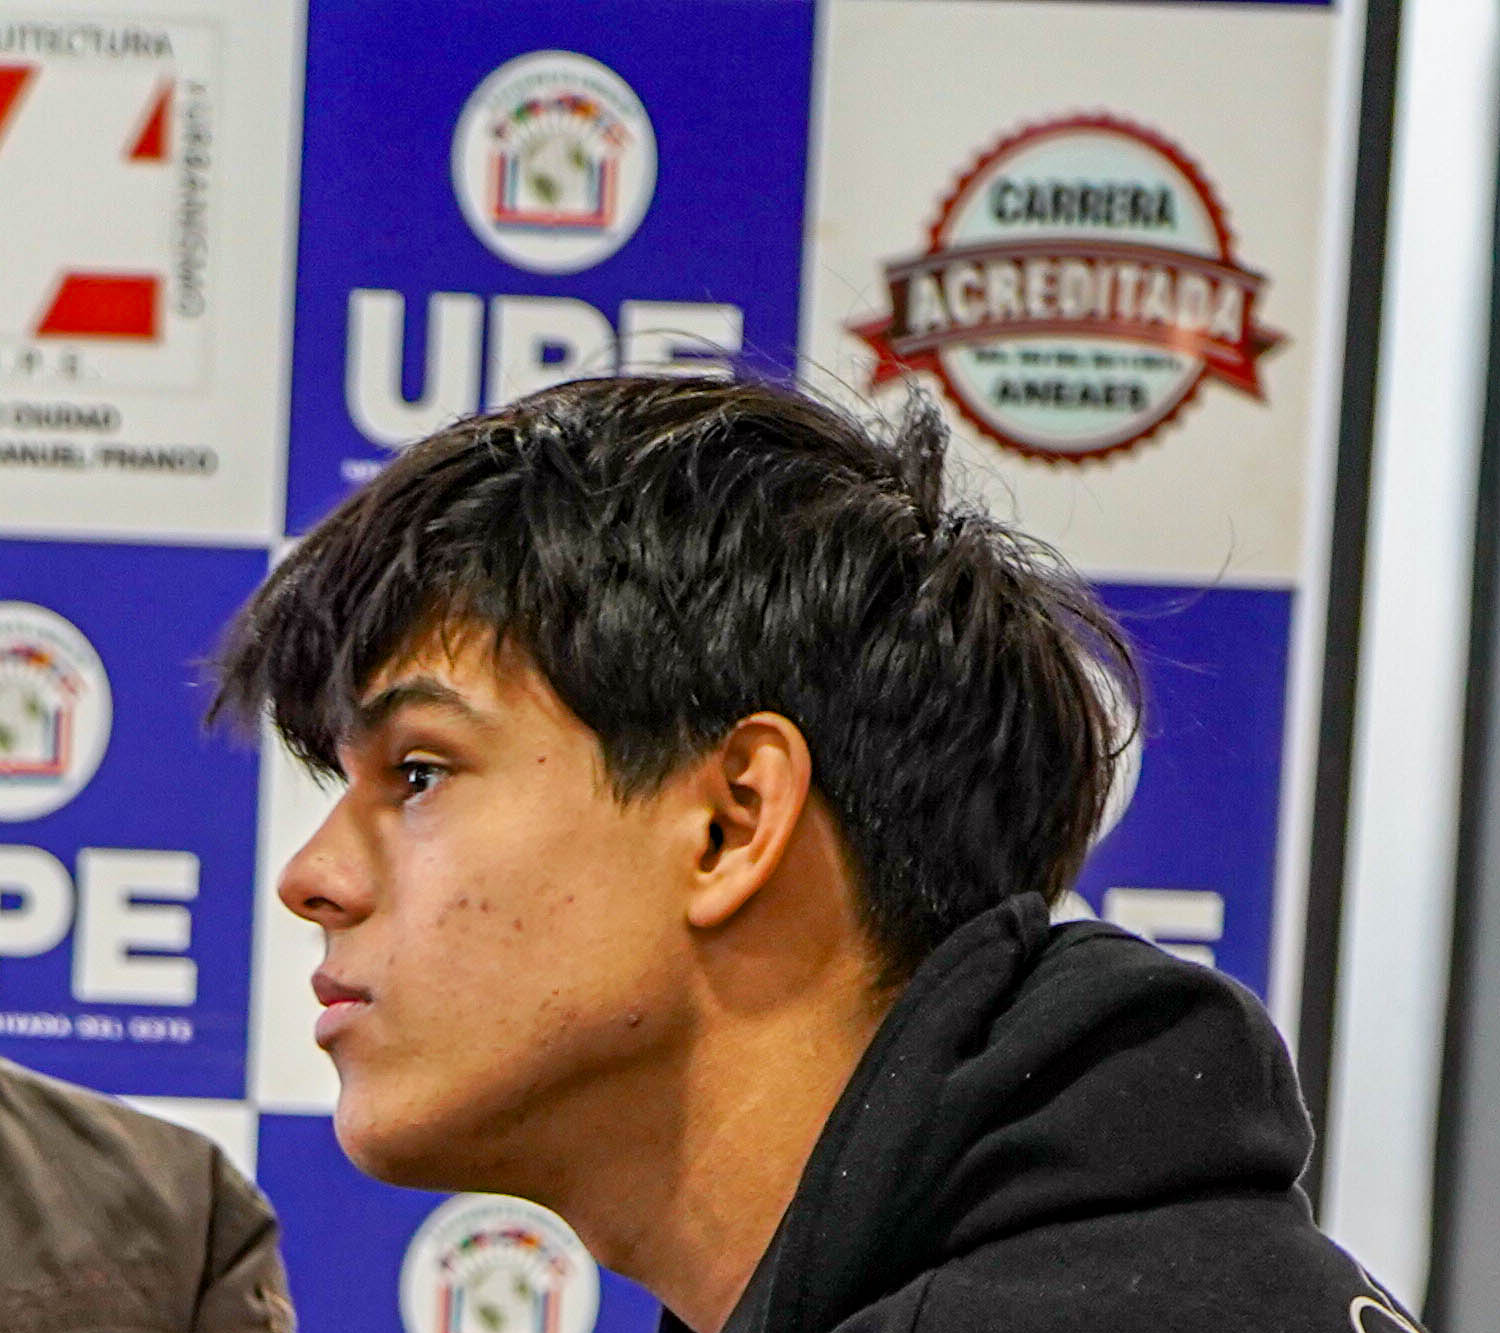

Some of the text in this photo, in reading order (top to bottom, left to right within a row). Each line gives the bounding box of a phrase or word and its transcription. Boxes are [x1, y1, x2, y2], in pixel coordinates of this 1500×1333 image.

[991, 176, 1178, 229] CARRERA
[906, 256, 1244, 343] ACREDITADA
[996, 377, 1149, 412] ANEAES
[8, 401, 122, 432] CIUDAD
[93, 443, 219, 475] FRANCO
